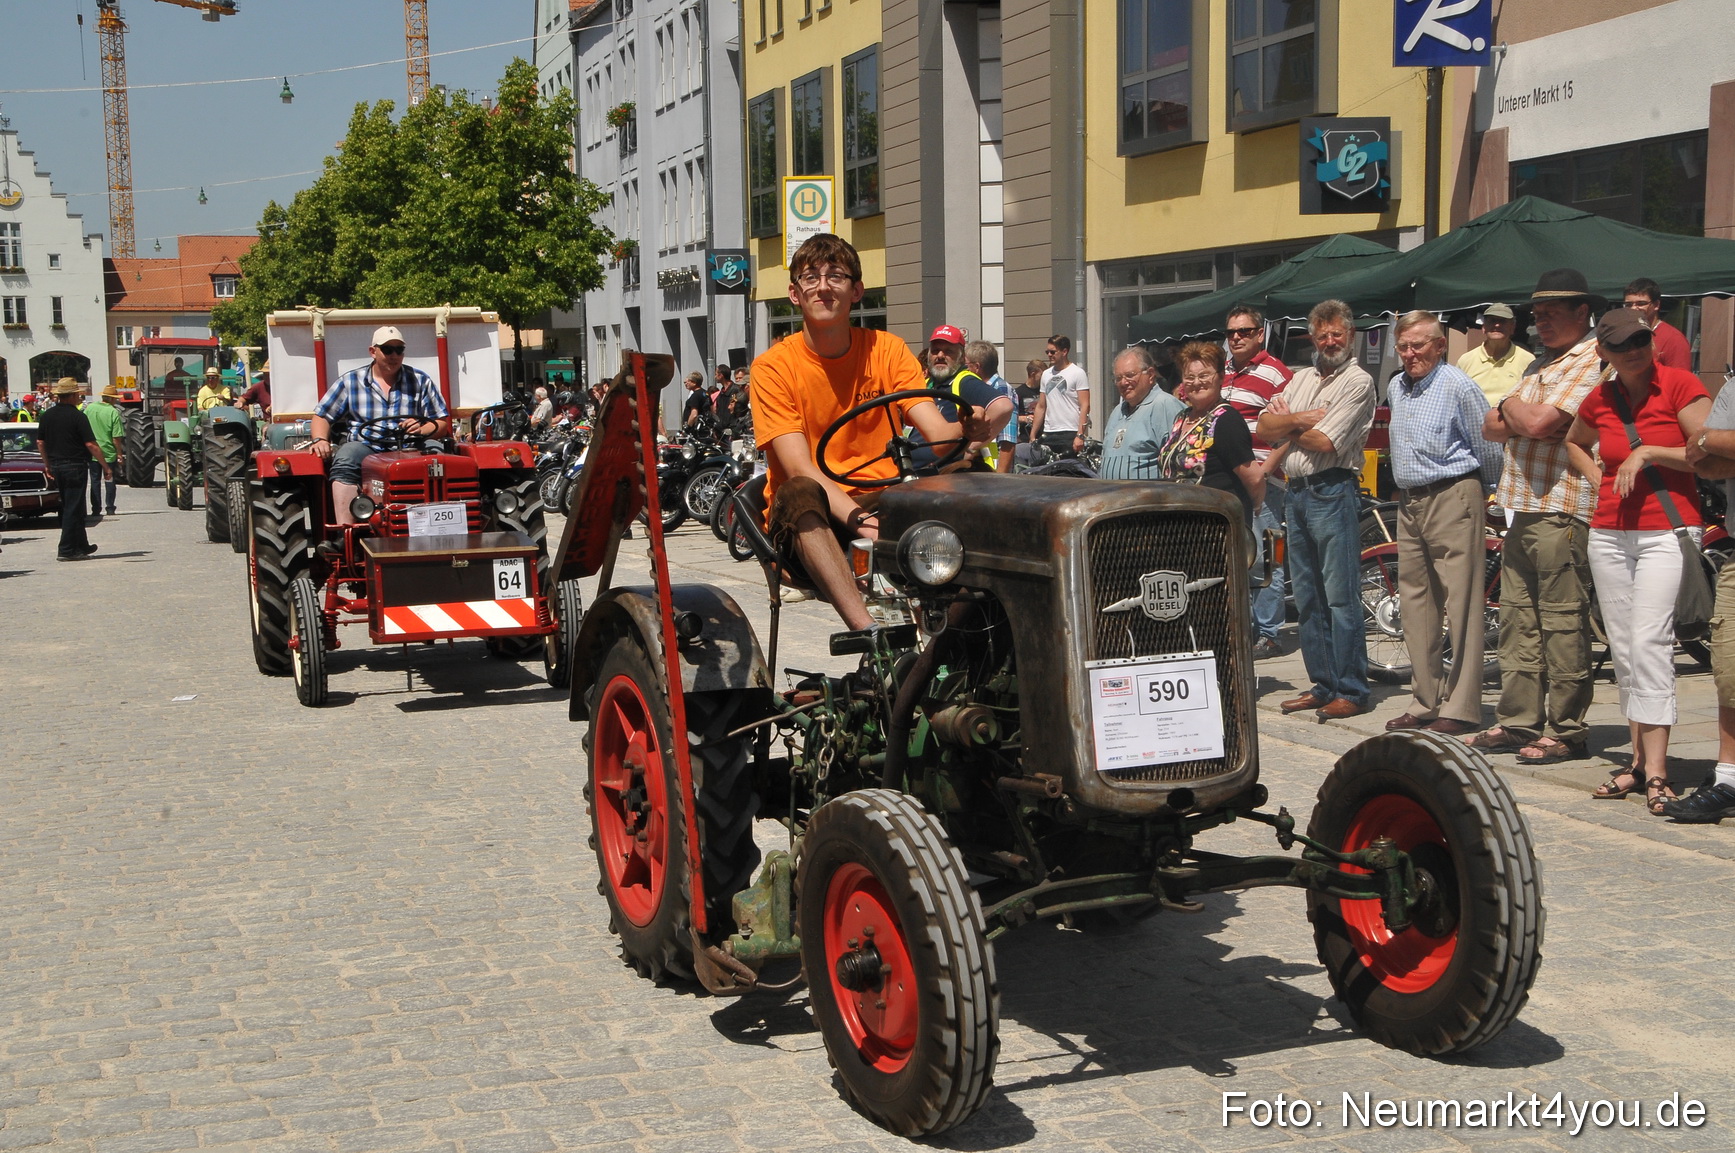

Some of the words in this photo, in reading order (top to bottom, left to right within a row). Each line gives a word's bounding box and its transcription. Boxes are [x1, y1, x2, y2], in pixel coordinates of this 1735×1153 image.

[1498, 93, 1531, 114] Unterer
[1533, 85, 1560, 106] Markt
[1562, 80, 1574, 100] 15
[800, 191, 817, 214] H
[434, 511, 454, 521] 250
[499, 559, 518, 567] ADAC
[498, 571, 522, 590] 64
[1149, 581, 1180, 600] HELA
[1149, 602, 1181, 611] DIESEL
[1149, 679, 1190, 702] 590
